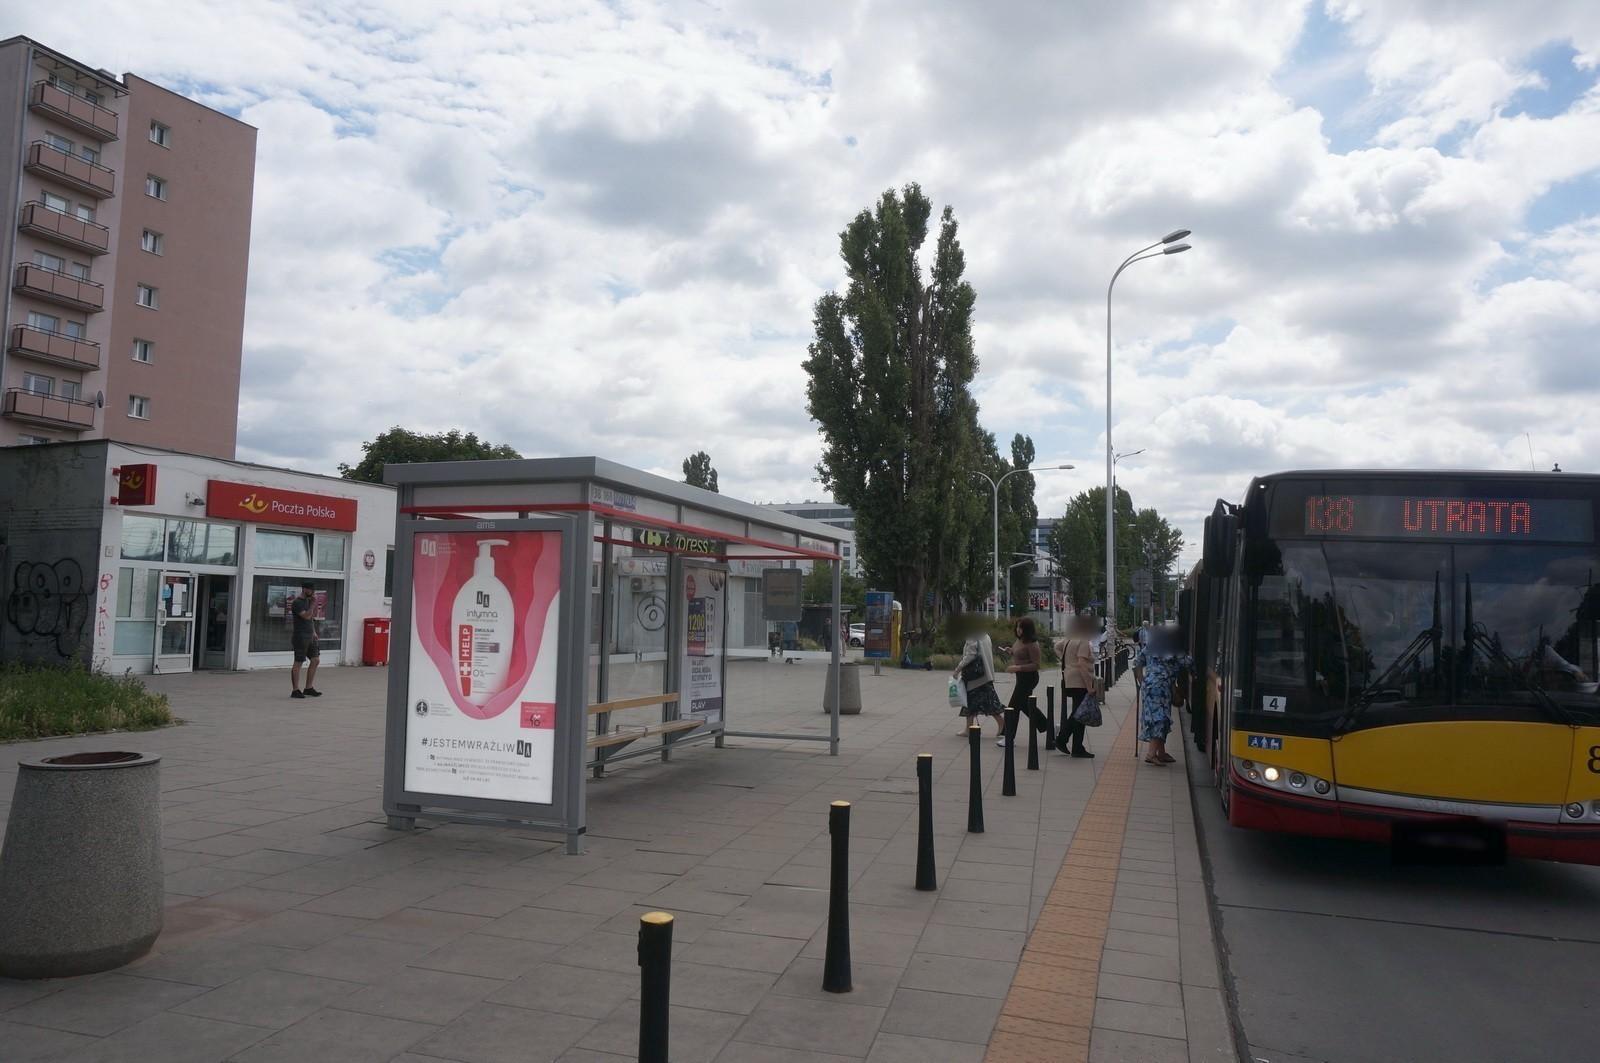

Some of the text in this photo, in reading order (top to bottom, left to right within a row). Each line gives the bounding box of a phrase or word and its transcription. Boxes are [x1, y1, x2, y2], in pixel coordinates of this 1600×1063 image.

[272, 500, 336, 519] Poczta Polska
[1306, 495, 1531, 535] 138 UTRATA
[476, 521, 496, 529] ams
[461, 627, 471, 657] HELP
[1269, 697, 1279, 710] 4
